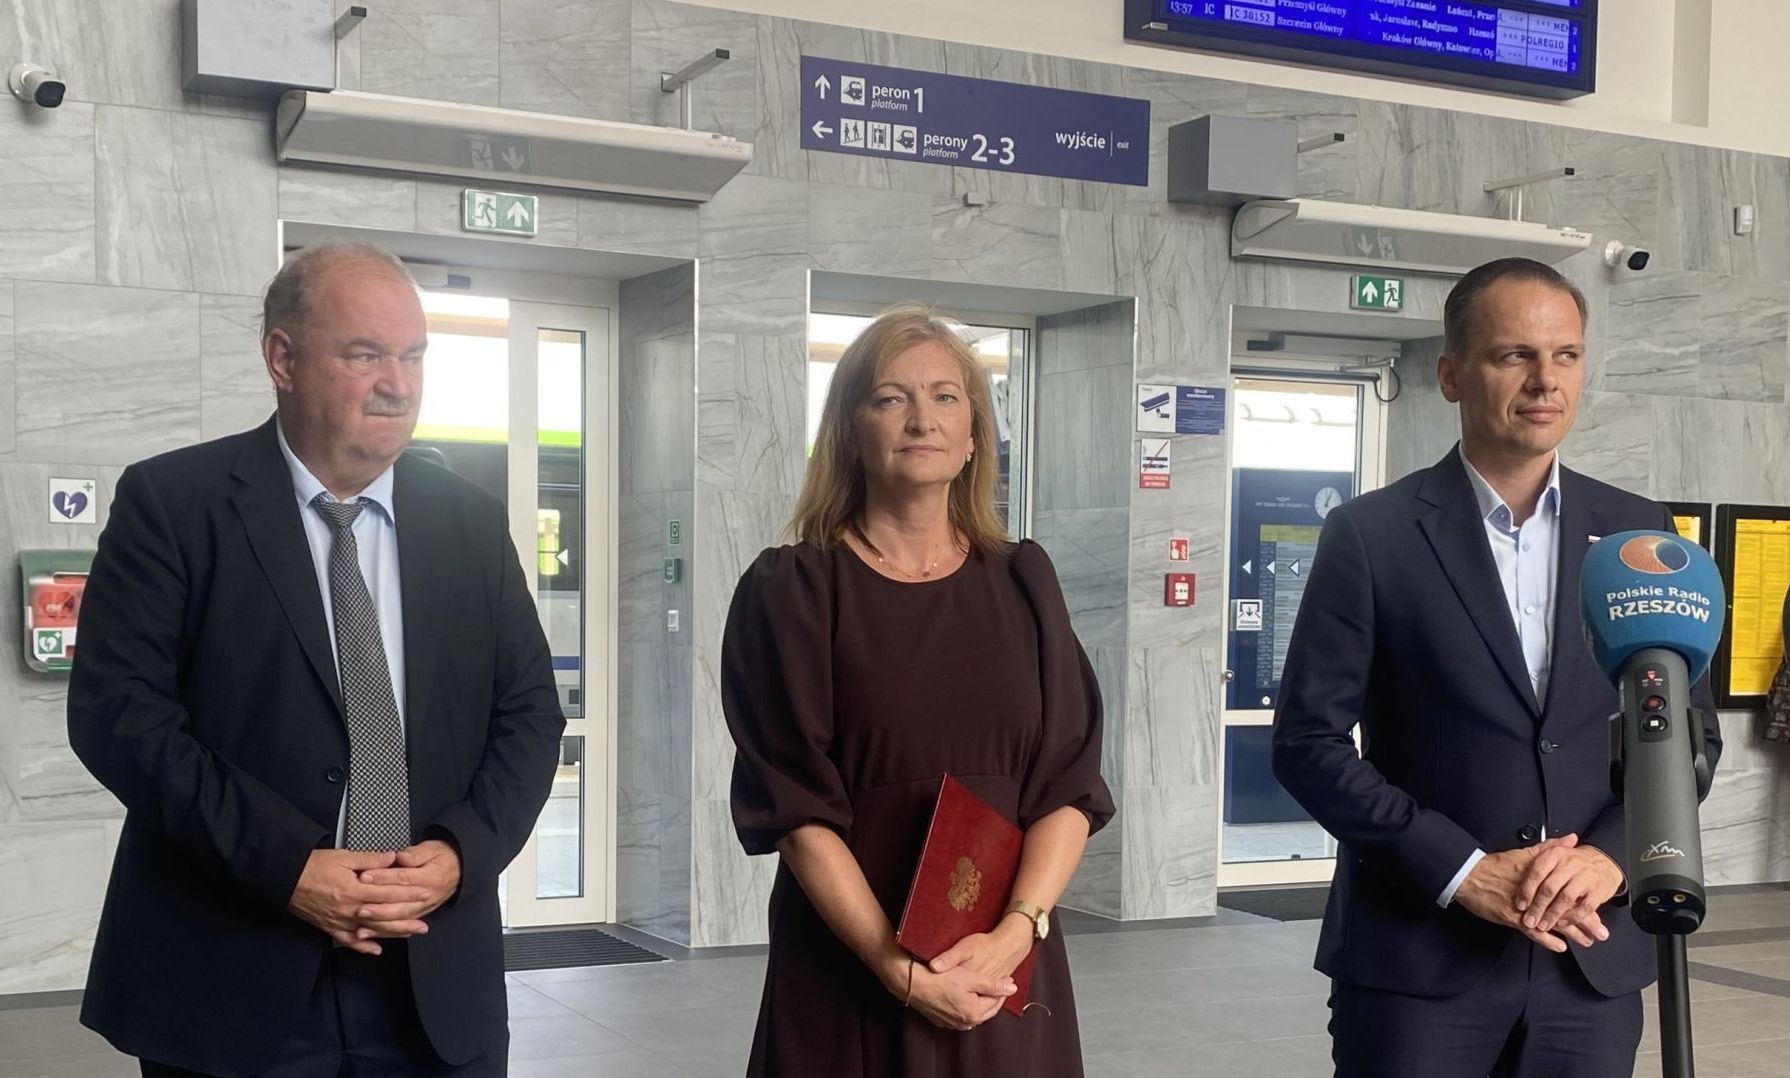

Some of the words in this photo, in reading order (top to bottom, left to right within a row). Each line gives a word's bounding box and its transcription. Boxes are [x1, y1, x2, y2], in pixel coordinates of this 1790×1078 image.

[1170, 1, 1193, 15] 13:57
[1204, 2, 1216, 15] IC
[1243, 10, 1270, 22] 38152
[1277, 16, 1312, 29] Szczecin
[1313, 22, 1344, 36] Główny
[1316, 3, 1347, 18] Główny
[1382, 32, 1412, 44] Kraków
[1413, 36, 1445, 51] Główny,
[1520, 34, 1565, 49] POLREGIO
[871, 98, 908, 112] platform
[872, 83, 910, 101] peron
[913, 87, 925, 113] 1
[923, 133, 968, 152] perony
[971, 134, 1015, 166] 2-3
[1055, 130, 1107, 152] wyjście
[1117, 140, 1129, 150] exit
[922, 146, 960, 160] platform
[1606, 587, 1663, 603] Polskie
[1668, 587, 1711, 605] Radio
[1609, 598, 1710, 623] RZESZÓW
